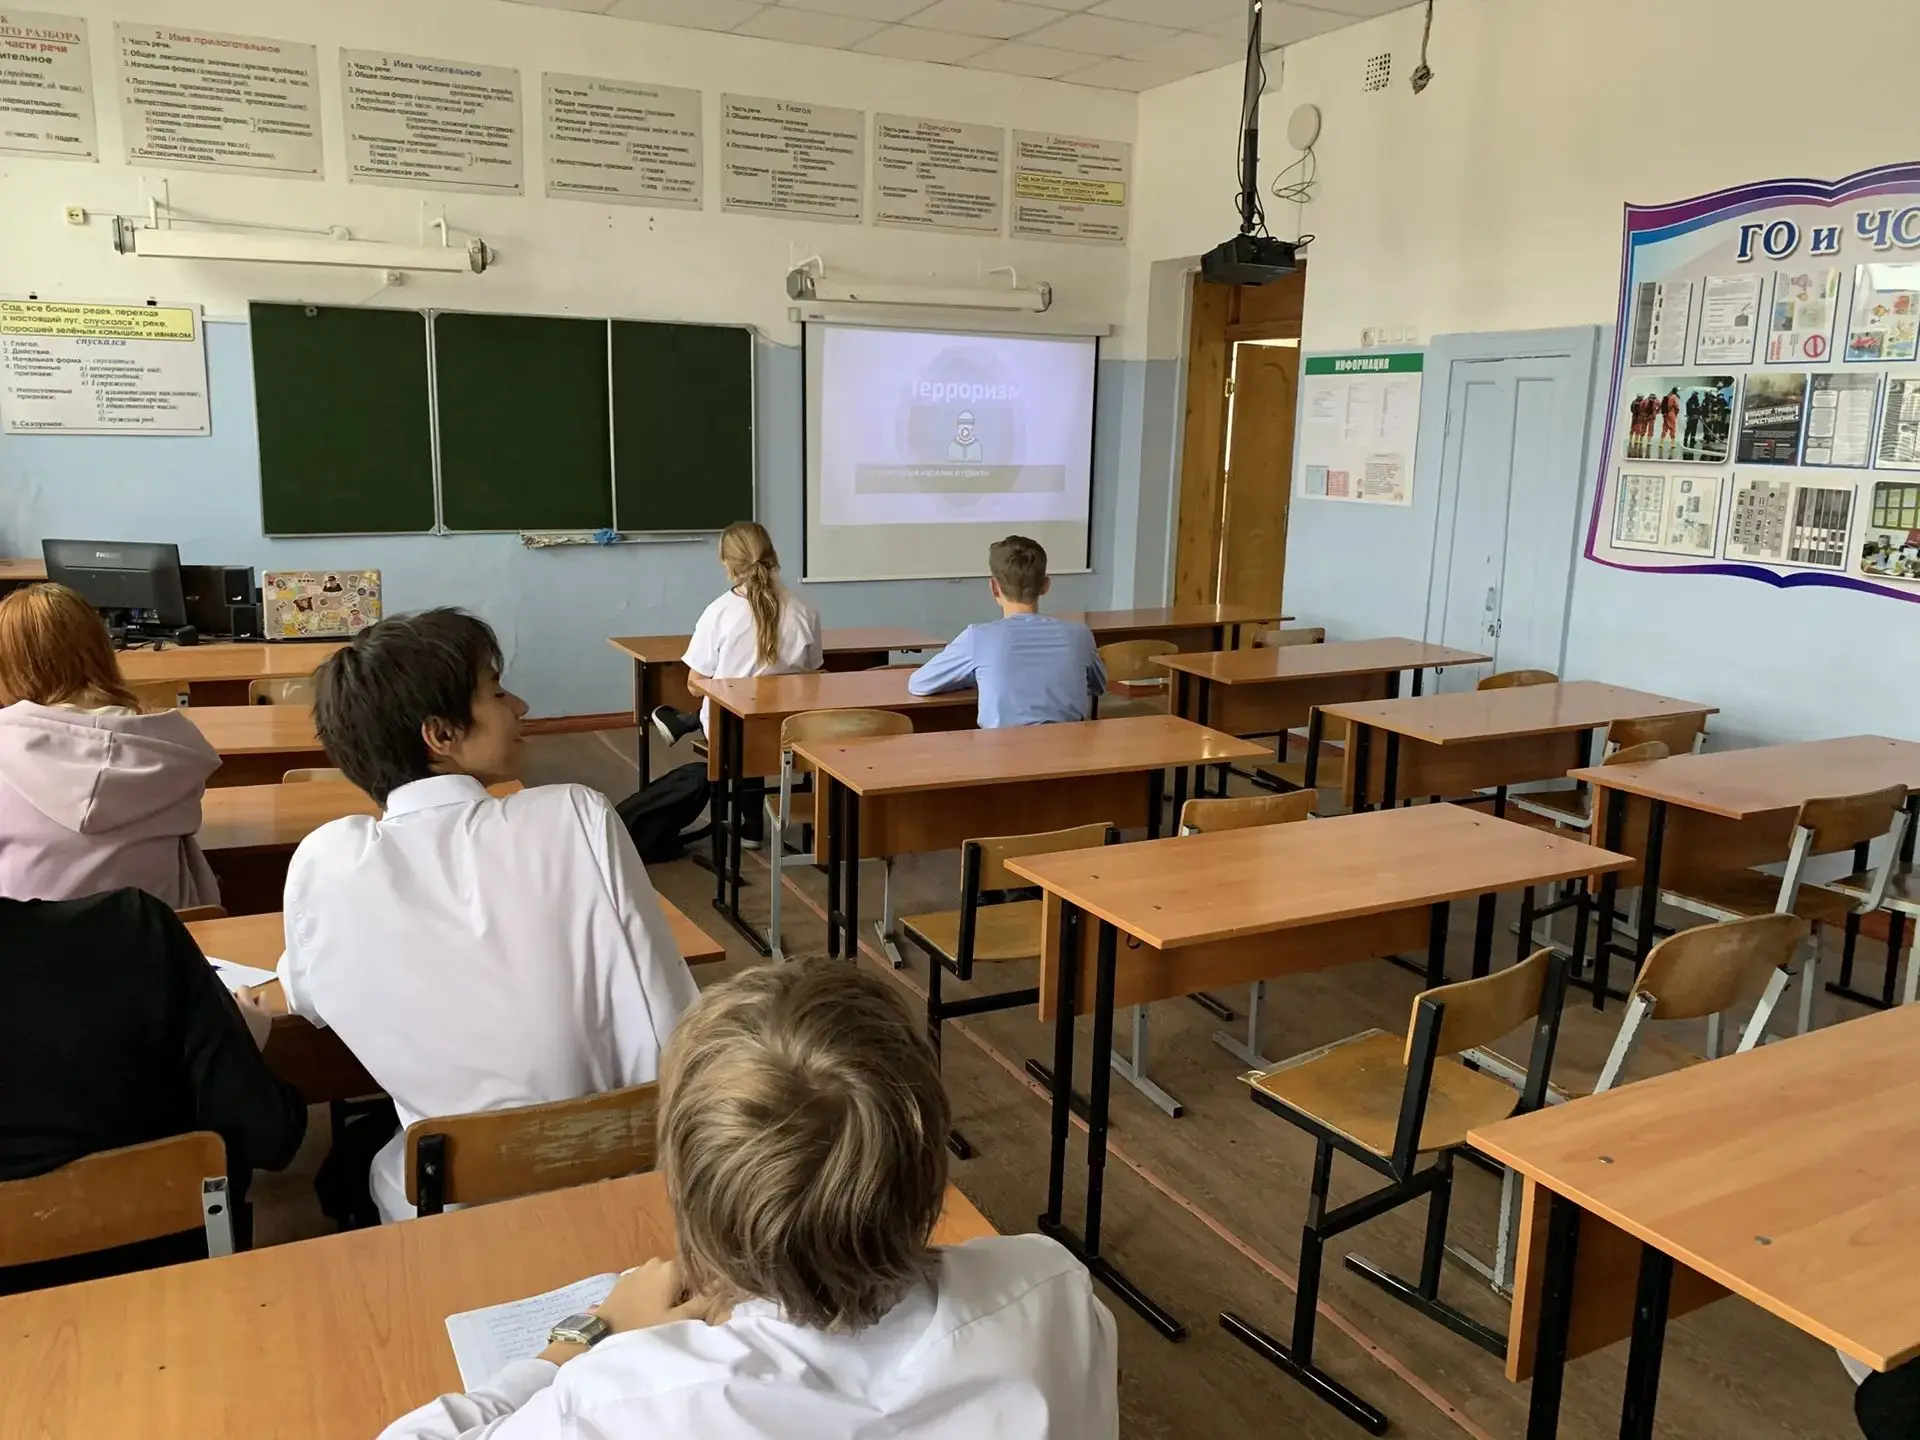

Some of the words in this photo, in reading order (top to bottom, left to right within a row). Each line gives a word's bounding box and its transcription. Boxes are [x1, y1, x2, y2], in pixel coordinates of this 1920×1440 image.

[26, 28, 81, 41] РАЗБОРА
[5, 40, 36, 49] части
[40, 43, 68, 53] речи
[129, 38, 150, 46] Часть
[416, 63, 482, 77] числительное
[1736, 220, 1798, 259] ГО
[1810, 226, 1838, 253] и
[1, 303, 24, 312] Сад,
[45, 304, 80, 314] больше
[83, 308, 113, 317] редея,
[115, 309, 159, 317] переходя
[9, 315, 61, 323] настоящий
[83, 317, 132, 327] спускался
[3, 326, 54, 334] поросшей
[76, 338, 126, 348] спускался
[55, 357, 82, 365] форма
[1335, 358, 1390, 371] ИНФОРМАЦИЯ
